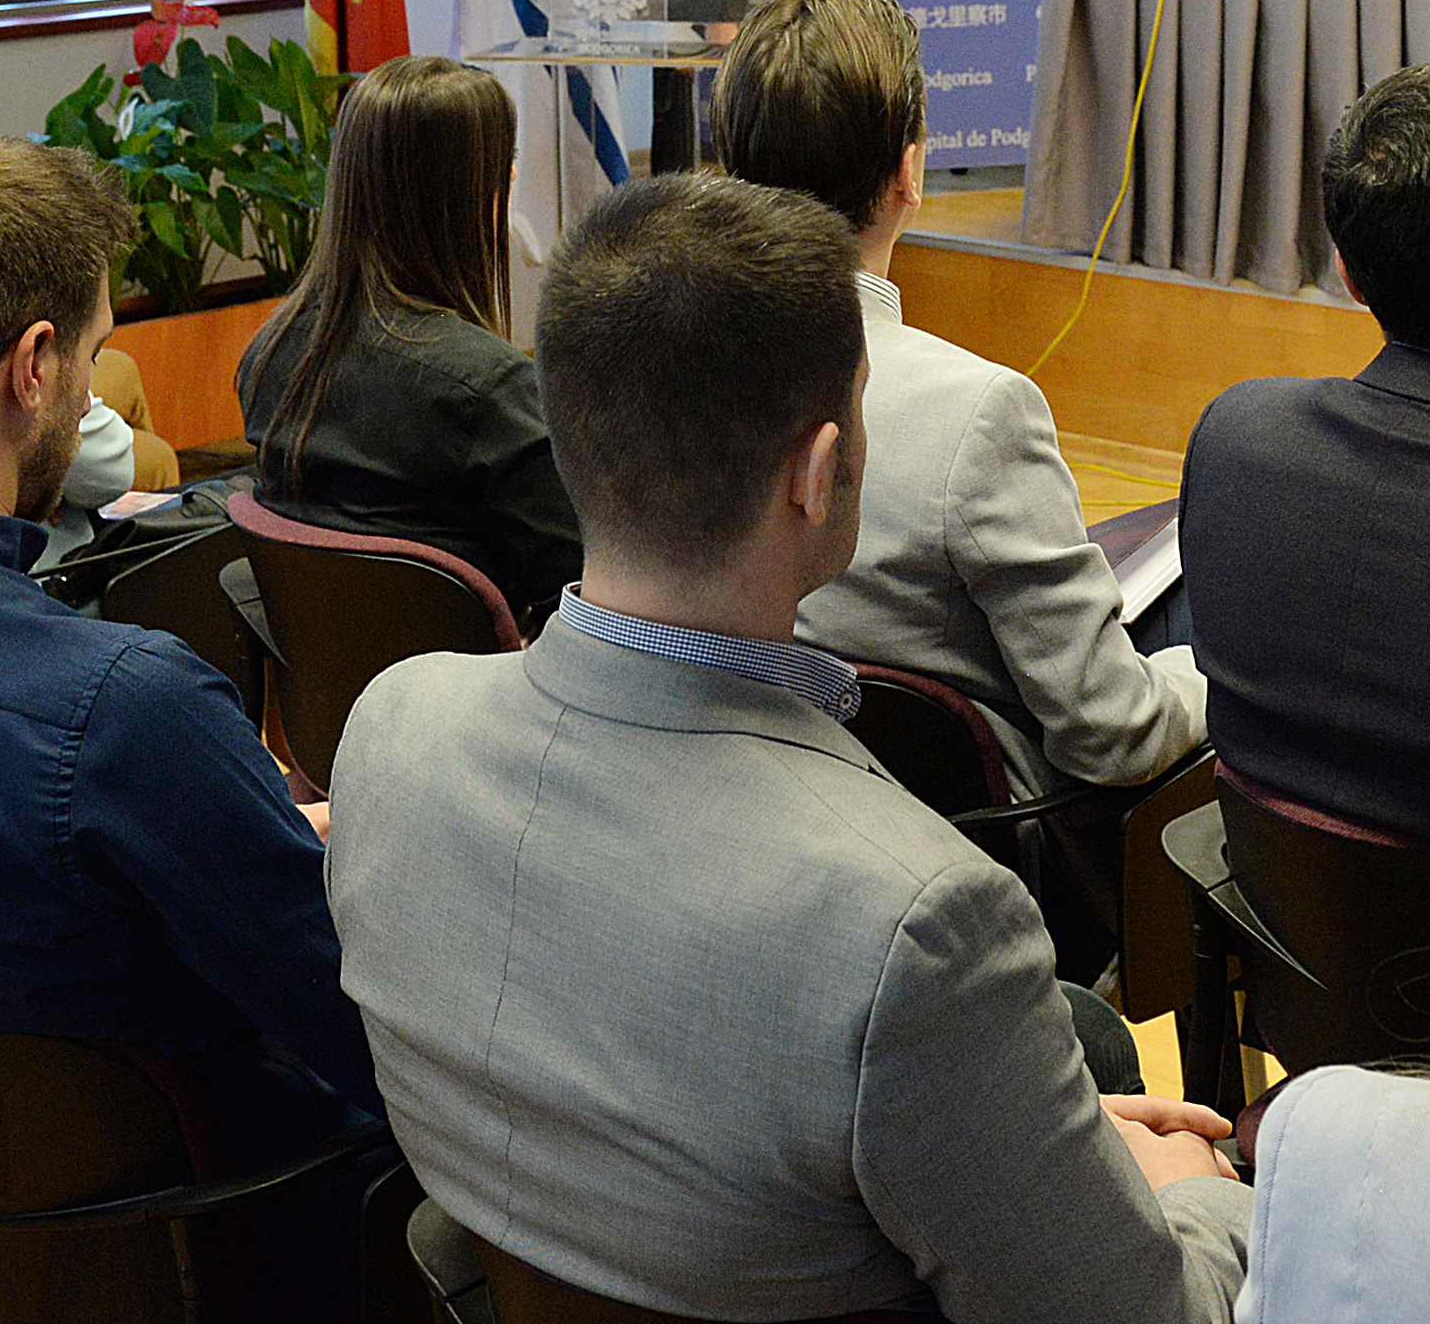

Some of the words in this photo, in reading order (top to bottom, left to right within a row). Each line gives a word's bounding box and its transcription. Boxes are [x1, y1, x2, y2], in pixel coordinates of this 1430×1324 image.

[923, 69, 993, 91] odgorica
[926, 130, 963, 154] pital
[967, 130, 987, 148] de
